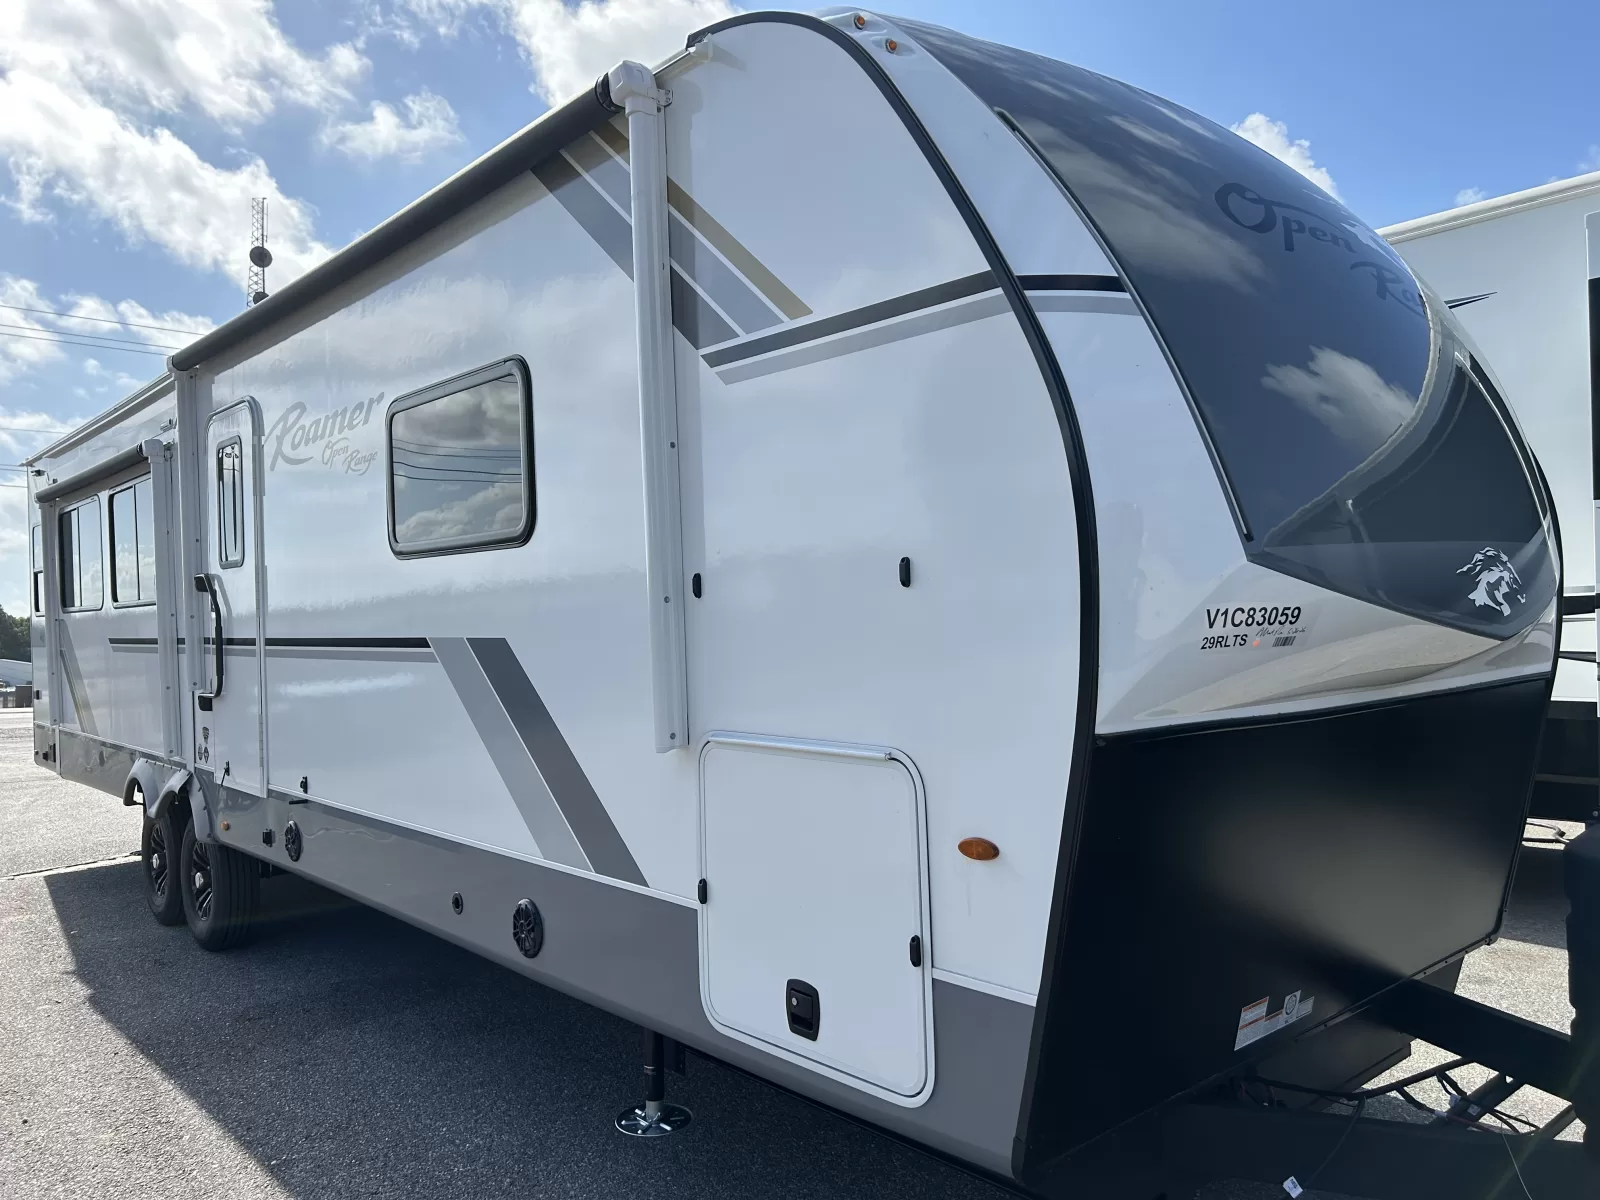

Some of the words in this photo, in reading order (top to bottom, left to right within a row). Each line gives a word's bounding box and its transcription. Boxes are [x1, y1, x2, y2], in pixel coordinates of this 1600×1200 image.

[1214, 182, 1357, 252] Open
[262, 392, 384, 471] Roamer
[322, 437, 351, 469] Open
[342, 449, 378, 476] Range
[1206, 606, 1302, 629] V1C83059
[1200, 634, 1248, 650] 29RLTS
